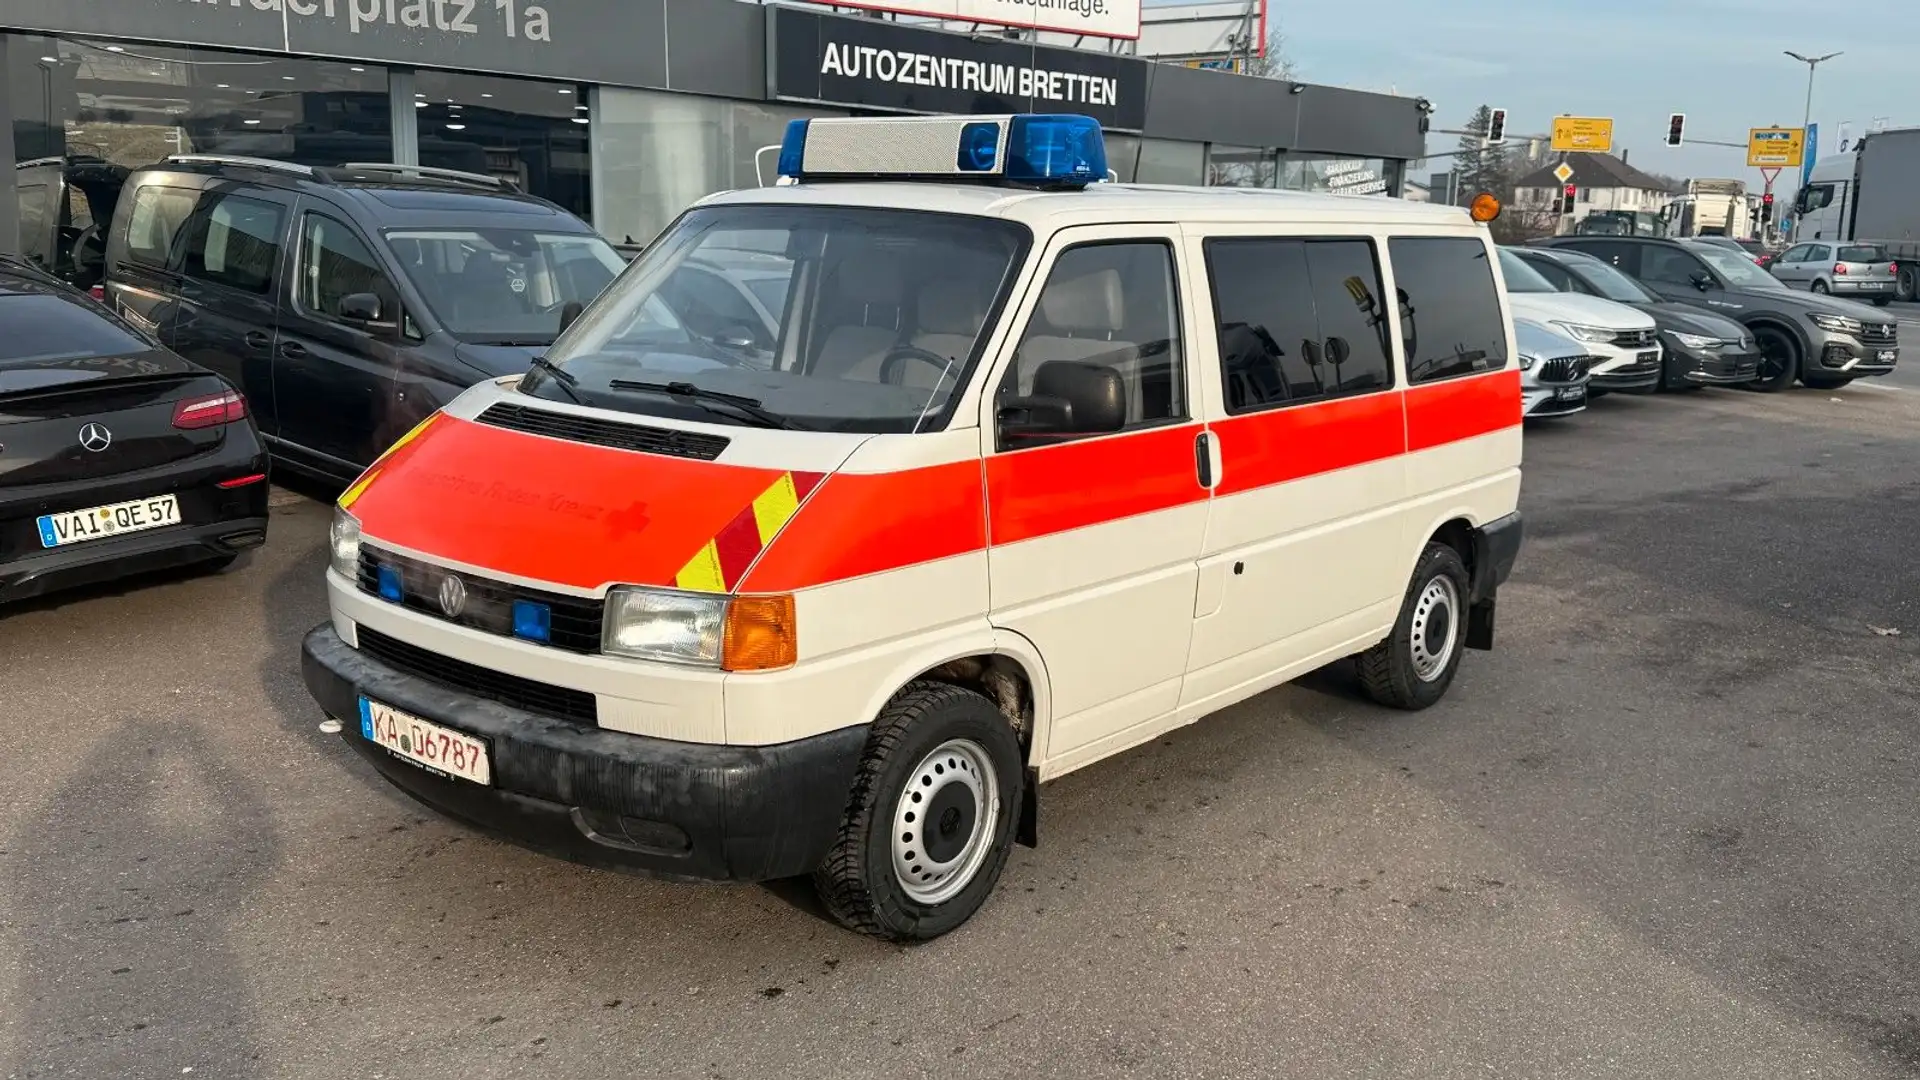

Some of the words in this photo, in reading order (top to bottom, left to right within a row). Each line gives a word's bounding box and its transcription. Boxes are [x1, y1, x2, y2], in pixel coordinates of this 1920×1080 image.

[496, 0, 551, 42] 1a
[821, 42, 1014, 95] AUTOZENTRUM
[1019, 68, 1117, 106] BRETTEN
[54, 513, 100, 539] VAI
[115, 505, 146, 528] QE
[148, 499, 173, 522] 57
[374, 711, 399, 748] KA
